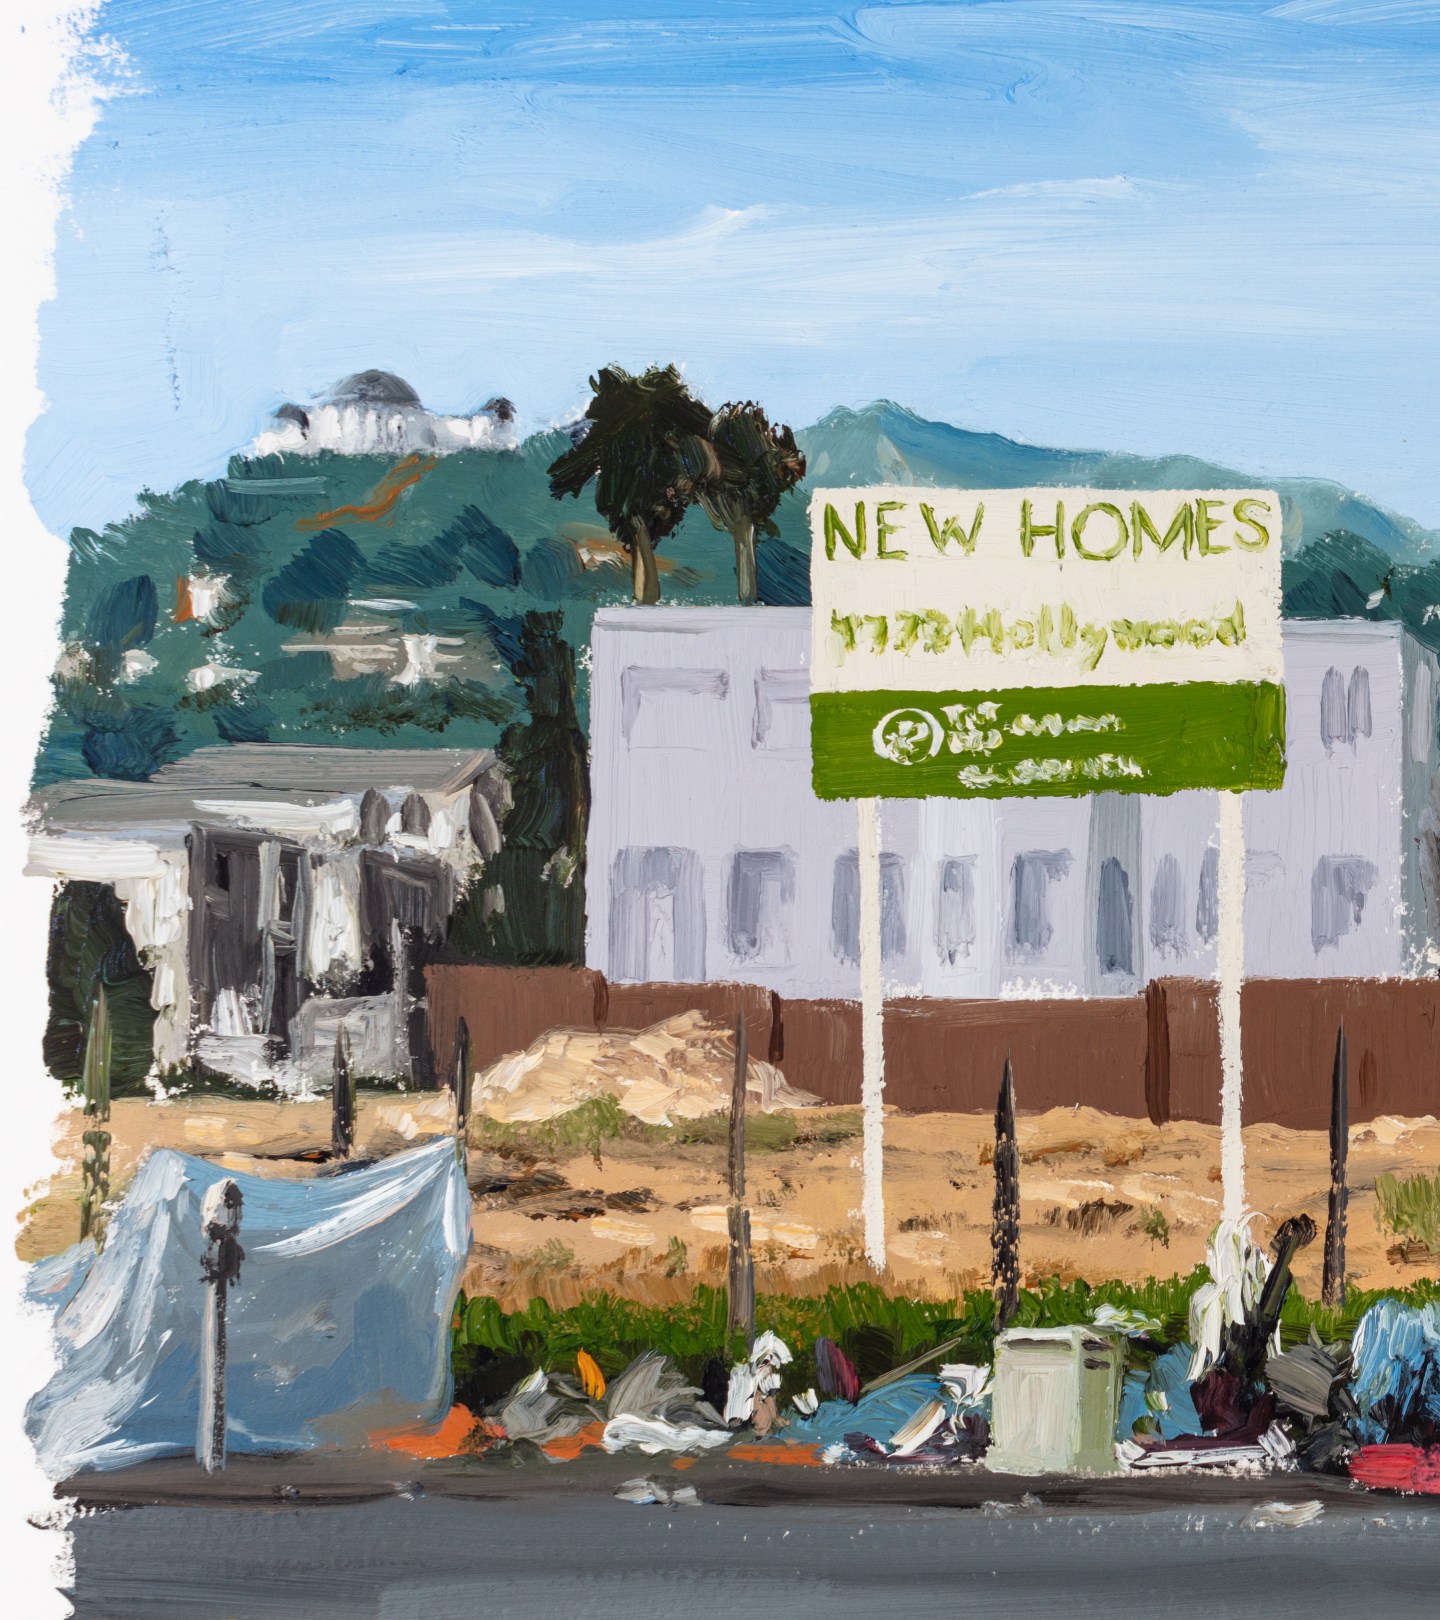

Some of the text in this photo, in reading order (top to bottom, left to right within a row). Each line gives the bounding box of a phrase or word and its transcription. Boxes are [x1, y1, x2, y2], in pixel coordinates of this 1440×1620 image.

[824, 498, 1271, 561] NEW HOMES
[956, 597, 1246, 671] Hollywood
